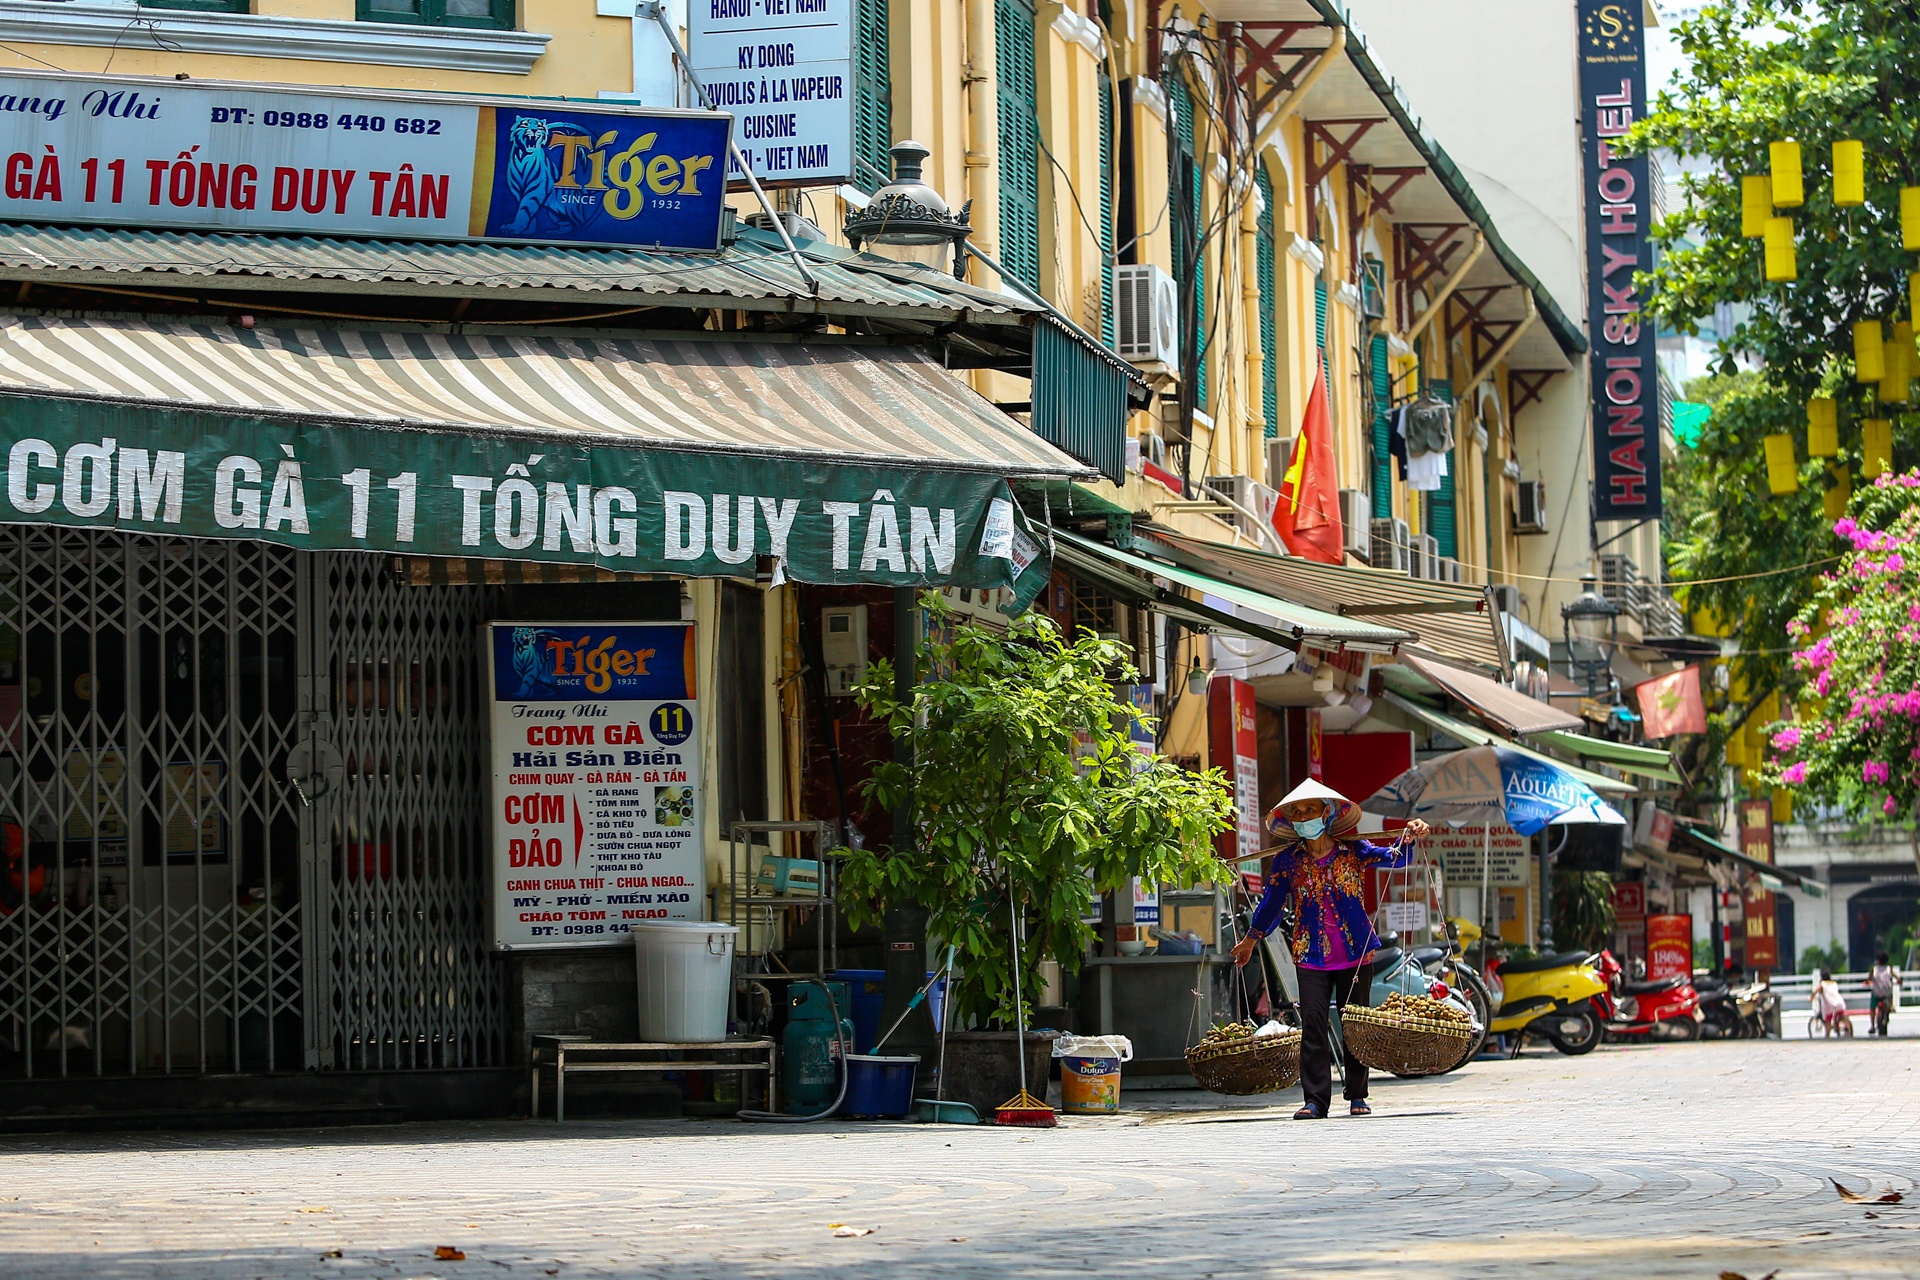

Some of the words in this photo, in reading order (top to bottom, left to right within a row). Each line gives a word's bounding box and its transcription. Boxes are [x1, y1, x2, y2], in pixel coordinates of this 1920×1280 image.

[711, 0, 751, 19] HANOI
[764, 0, 791, 16] VIET
[795, 0, 827, 13] NAM
[738, 46, 754, 70] KY
[758, 42, 795, 68] DONG
[759, 75, 769, 105] À
[772, 79, 788, 103] LA
[791, 75, 843, 101] VAPEUR
[82, 89, 162, 119] Nhi
[211, 106, 255, 125] ĐT:
[263, 109, 329, 130] 0988
[337, 113, 386, 132] 440
[394, 117, 442, 135] 682
[743, 113, 797, 140] CUISINE
[765, 146, 794, 171] VIET
[797, 144, 829, 168] NAM
[1595, 78, 1637, 235] HOTEL
[5, 144, 63, 202] GÀ
[80, 157, 125, 204] 11
[146, 144, 258, 211] TỐNG
[271, 166, 356, 215] DUY
[368, 163, 450, 220] TÂN
[548, 129, 714, 220] Tiger
[561, 193, 596, 205] SINCE
[651, 199, 681, 210] 1932
[1602, 243, 1640, 346] SKY
[1605, 356, 1646, 506] HANOI
[7, 437, 186, 525] CƠM
[212, 443, 311, 535] GÀ
[341, 467, 417, 543] 11
[452, 454, 638, 559] TỐNG
[663, 490, 801, 592] DUY
[822, 488, 956, 575] TÂN
[546, 635, 656, 693] Tiger
[557, 678, 580, 686] SINCE
[511, 704, 567, 720] Trang
[572, 704, 608, 717] Nhi
[657, 707, 684, 732] 11
[527, 725, 595, 746] CƠM
[604, 720, 644, 745] GÀ
[513, 750, 557, 767] Hải
[566, 750, 615, 766] Sản
[624, 746, 682, 765] Biển
[509, 773, 541, 785] CHIM
[545, 773, 575, 784] QUAY
[587, 771, 603, 784] GÀ
[606, 769, 632, 783] RÁN
[643, 769, 660, 783] GÀ
[595, 788, 609, 796] GÀ
[504, 792, 565, 825] CƠM
[595, 799, 617, 807] TÔM
[620, 799, 639, 807] RIM
[596, 810, 610, 818] CÁ
[612, 810, 632, 818] KHO
[634, 809, 648, 819] TỘ
[613, 820, 634, 828] TIÊU
[1490, 826, 1521, 836] QUA
[597, 831, 617, 840] DƯA
[642, 830, 663, 839] DƯA
[508, 828, 563, 868] ĐẢO
[597, 841, 624, 850] SƯỜN
[655, 841, 681, 850] NGỌT
[597, 853, 618, 862] THỊT
[620, 852, 641, 860] KHO
[643, 851, 662, 860] TÀU
[597, 864, 628, 872] KHOAI
[507, 879, 541, 892] CANH
[544, 879, 576, 891] CHUA
[579, 877, 605, 892] THỊT
[617, 877, 649, 888] CHUA
[557, 893, 592, 906] PHỞ
[607, 891, 652, 904] MIẾN
[657, 891, 690, 904] XÀO
[519, 911, 563, 922] CHÁO
[568, 909, 606, 921] TÔM
[622, 909, 668, 919] NGAO
[531, 926, 559, 936] ĐT:
[563, 925, 605, 935] 0988
[609, 924, 638, 934] 44
[1080, 1066, 1105, 1074] Dulux
